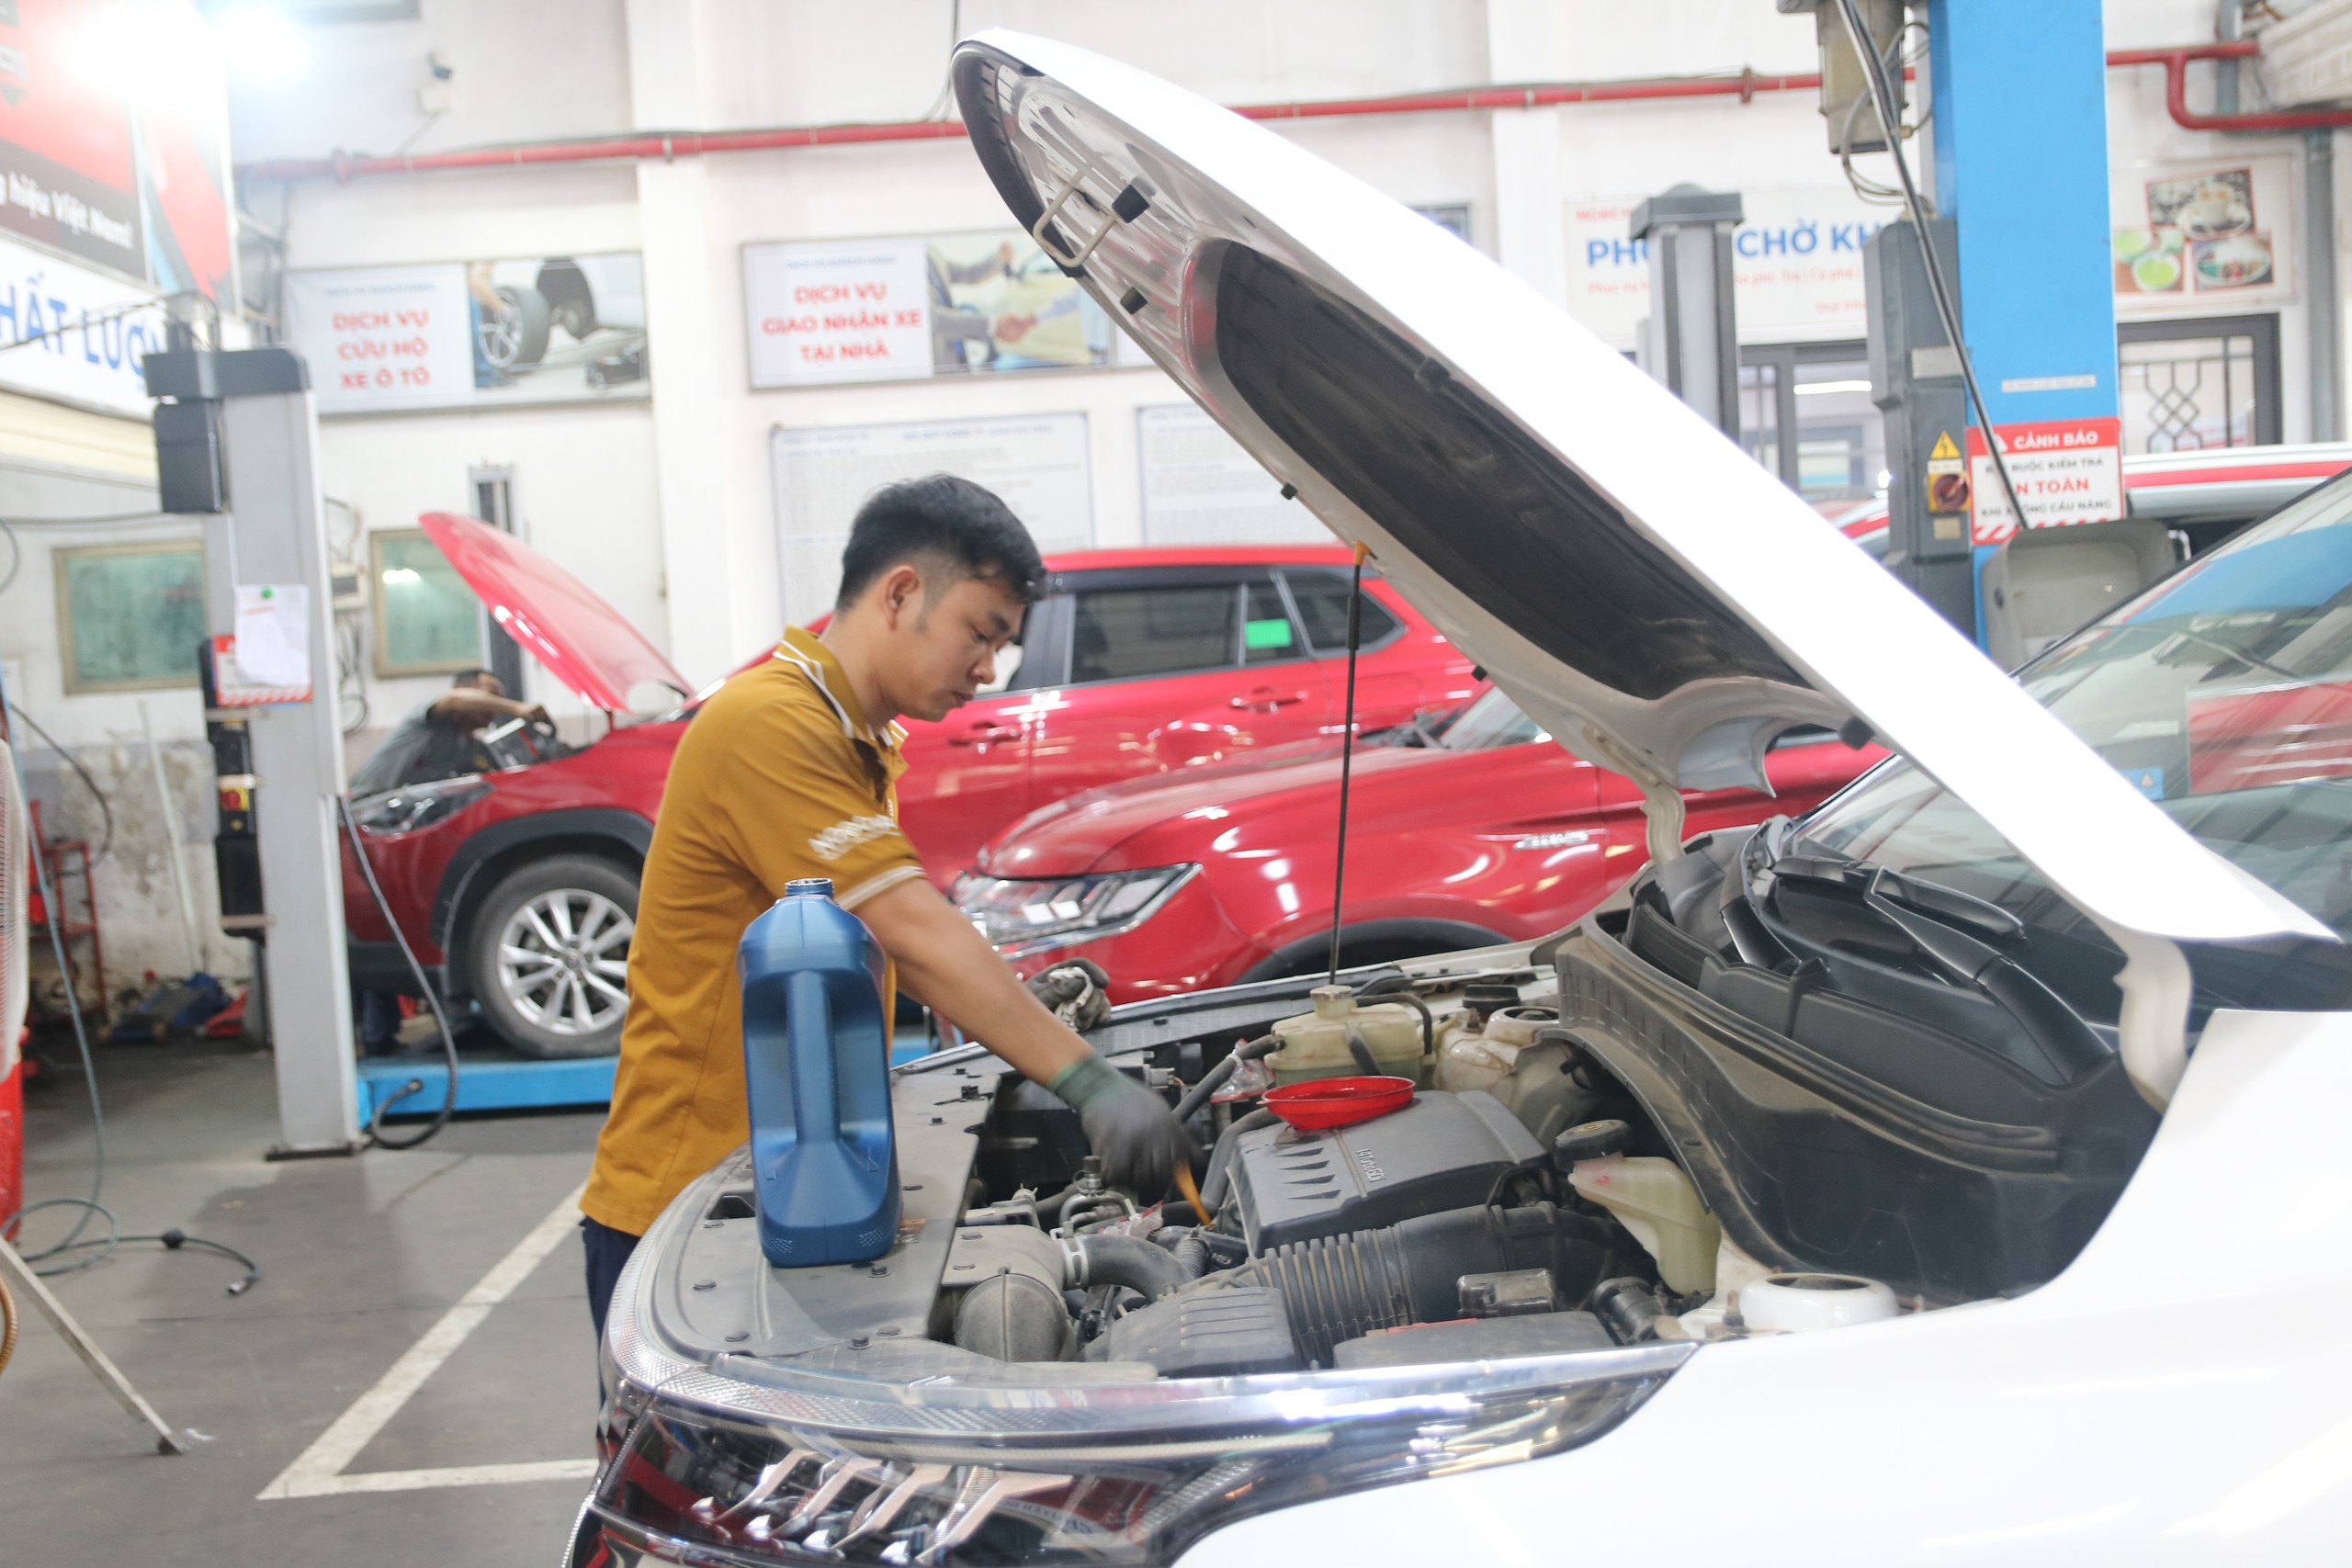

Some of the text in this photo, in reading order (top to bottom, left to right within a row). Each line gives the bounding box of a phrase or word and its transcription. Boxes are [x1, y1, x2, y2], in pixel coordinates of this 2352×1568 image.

[1587, 218, 1883, 267] PH CHỜ KH
[763, 314, 818, 335] GIAO
[895, 309, 922, 328] XE
[840, 337, 890, 361] NHÀ
[340, 369, 368, 389] XE
[398, 365, 431, 387] TÔ
[2013, 428, 2099, 450] CẢNH BÁO
[2035, 476, 2089, 496] TOÀN
